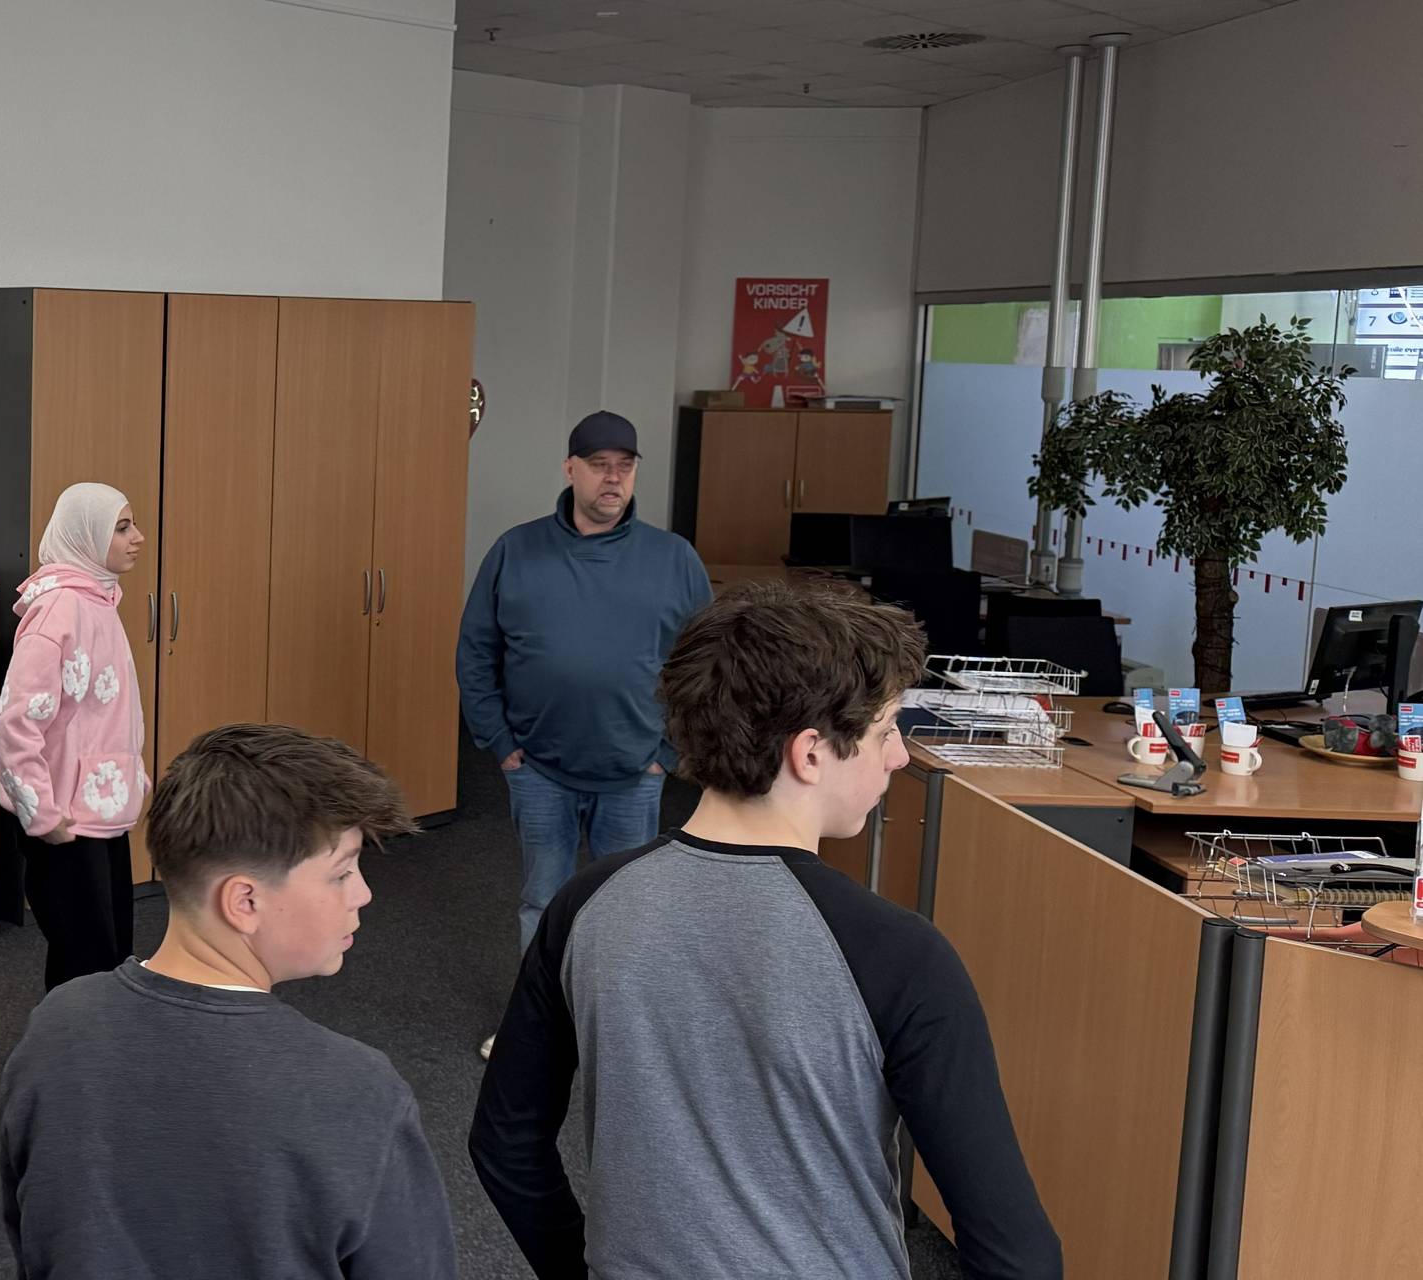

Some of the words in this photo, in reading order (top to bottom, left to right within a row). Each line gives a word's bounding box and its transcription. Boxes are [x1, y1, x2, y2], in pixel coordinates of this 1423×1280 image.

[746, 284, 818, 296] VORSICHT
[754, 298, 808, 309] KINDER
[1369, 316, 1377, 327] 7
